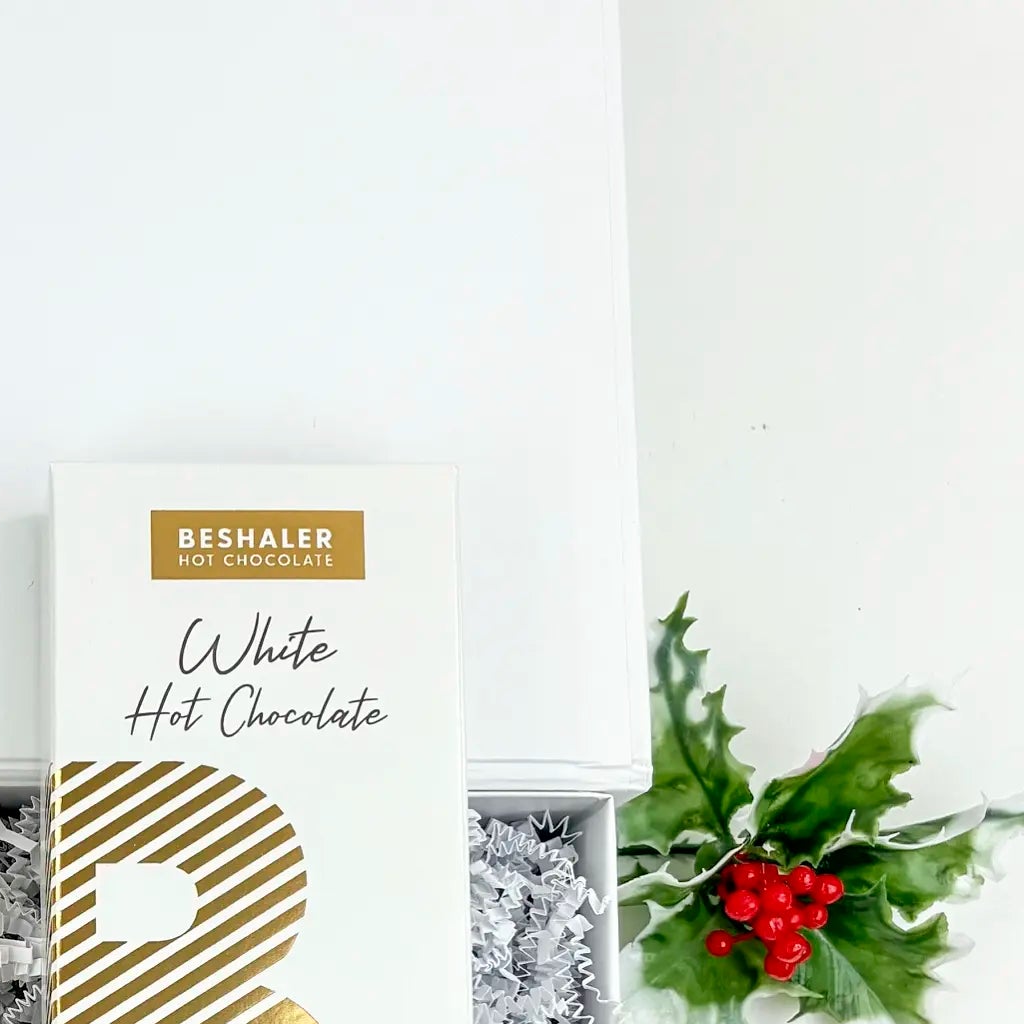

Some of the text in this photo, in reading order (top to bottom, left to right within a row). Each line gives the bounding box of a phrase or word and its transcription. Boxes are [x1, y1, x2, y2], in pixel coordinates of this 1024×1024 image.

[178, 527, 333, 549] BESHALER
[178, 553, 334, 568] HOT CHOCOLATE
[178, 611, 339, 676] White
[124, 681, 389, 742] Hot Chocolate
